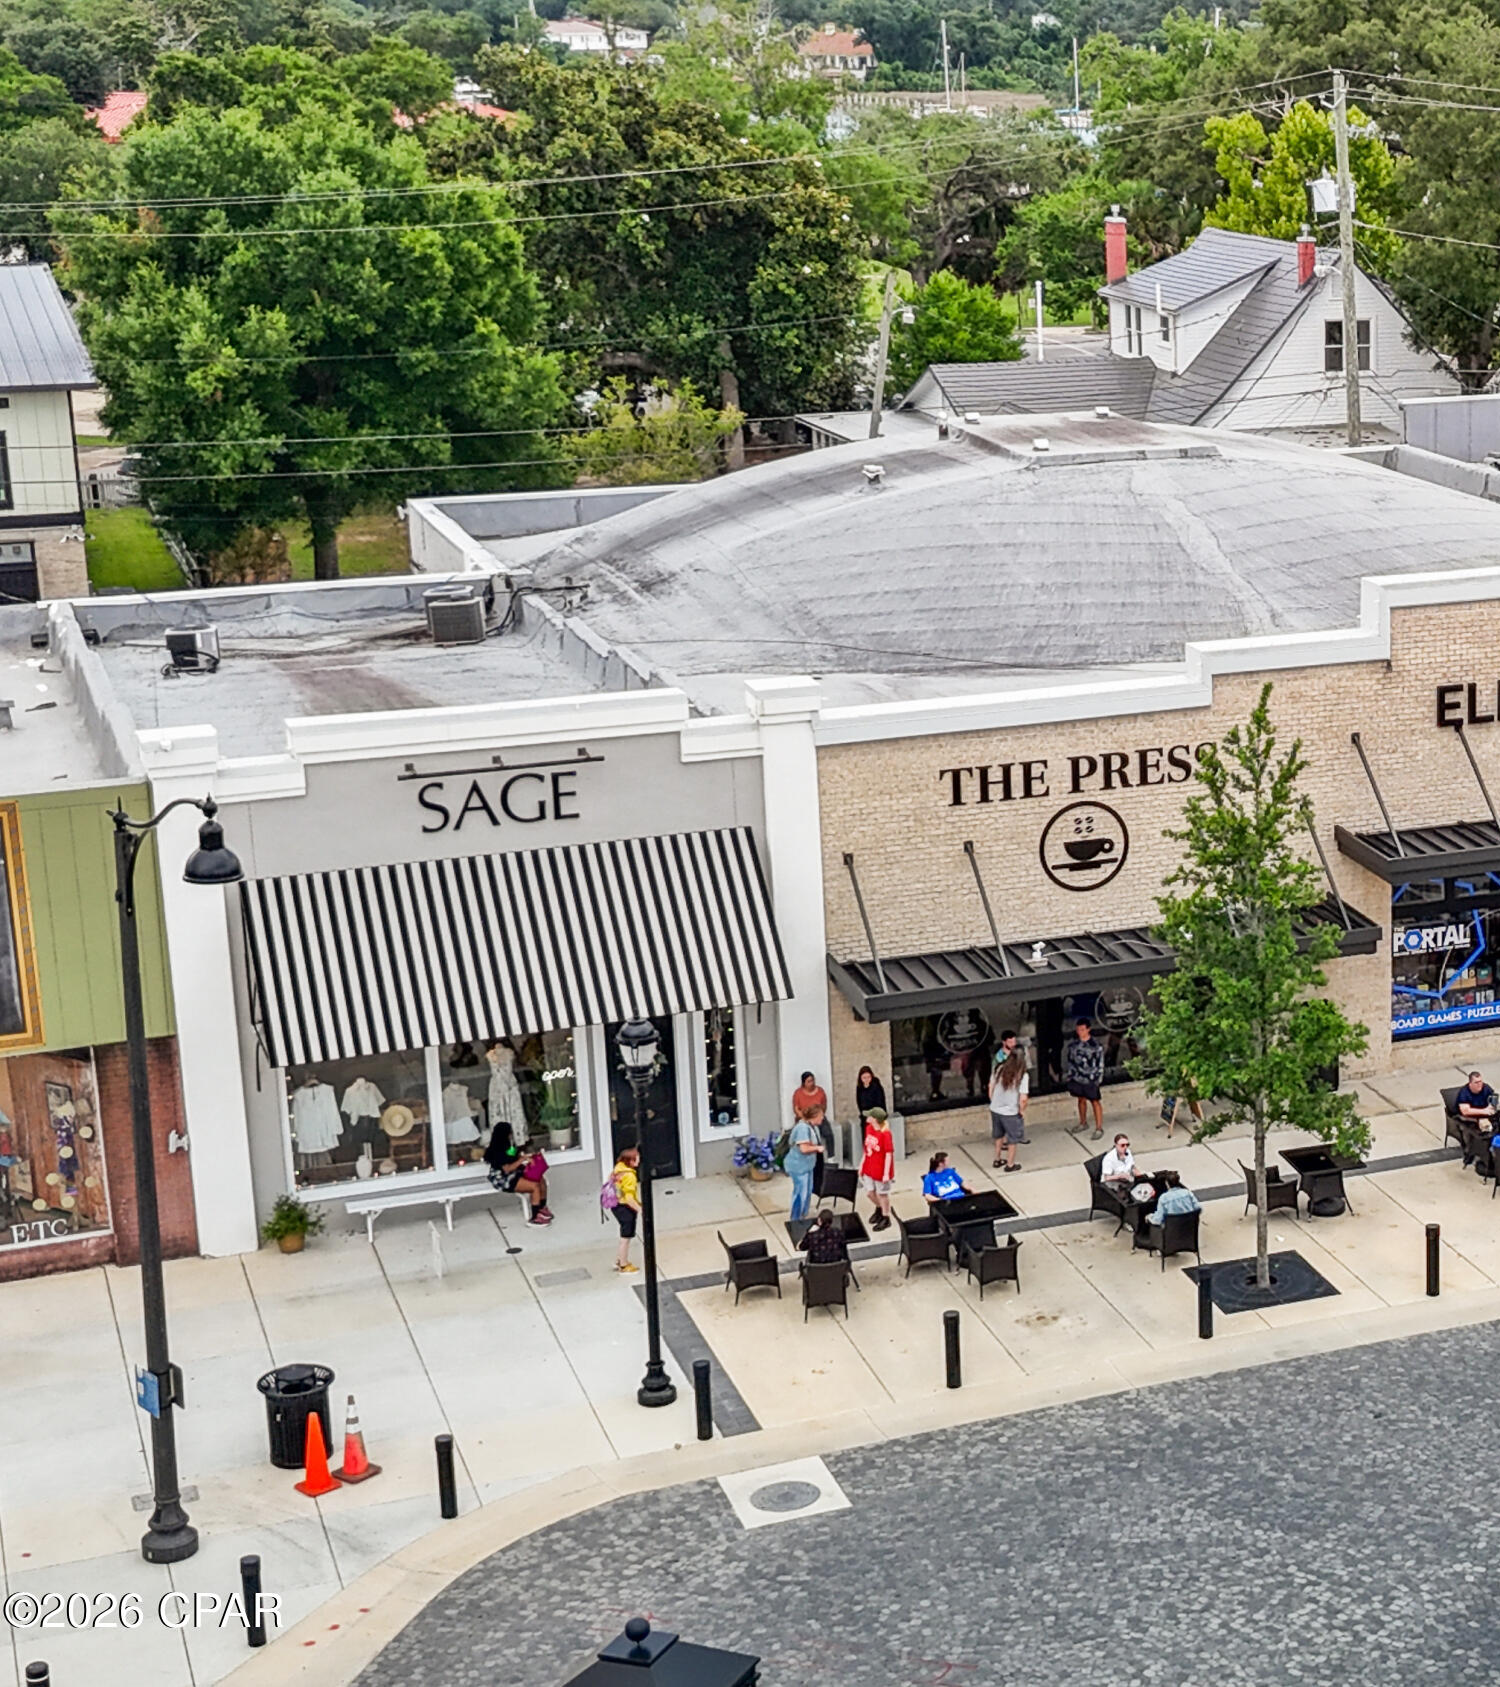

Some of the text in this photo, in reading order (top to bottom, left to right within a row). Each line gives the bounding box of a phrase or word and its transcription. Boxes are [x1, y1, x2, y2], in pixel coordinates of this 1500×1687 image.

[939, 759, 1050, 807] THE
[418, 770, 580, 833] SAGE
[1393, 924, 1471, 953] PORTAL
[1427, 1010, 1462, 1025] GAMES
[10, 1218, 68, 1244] ETC
